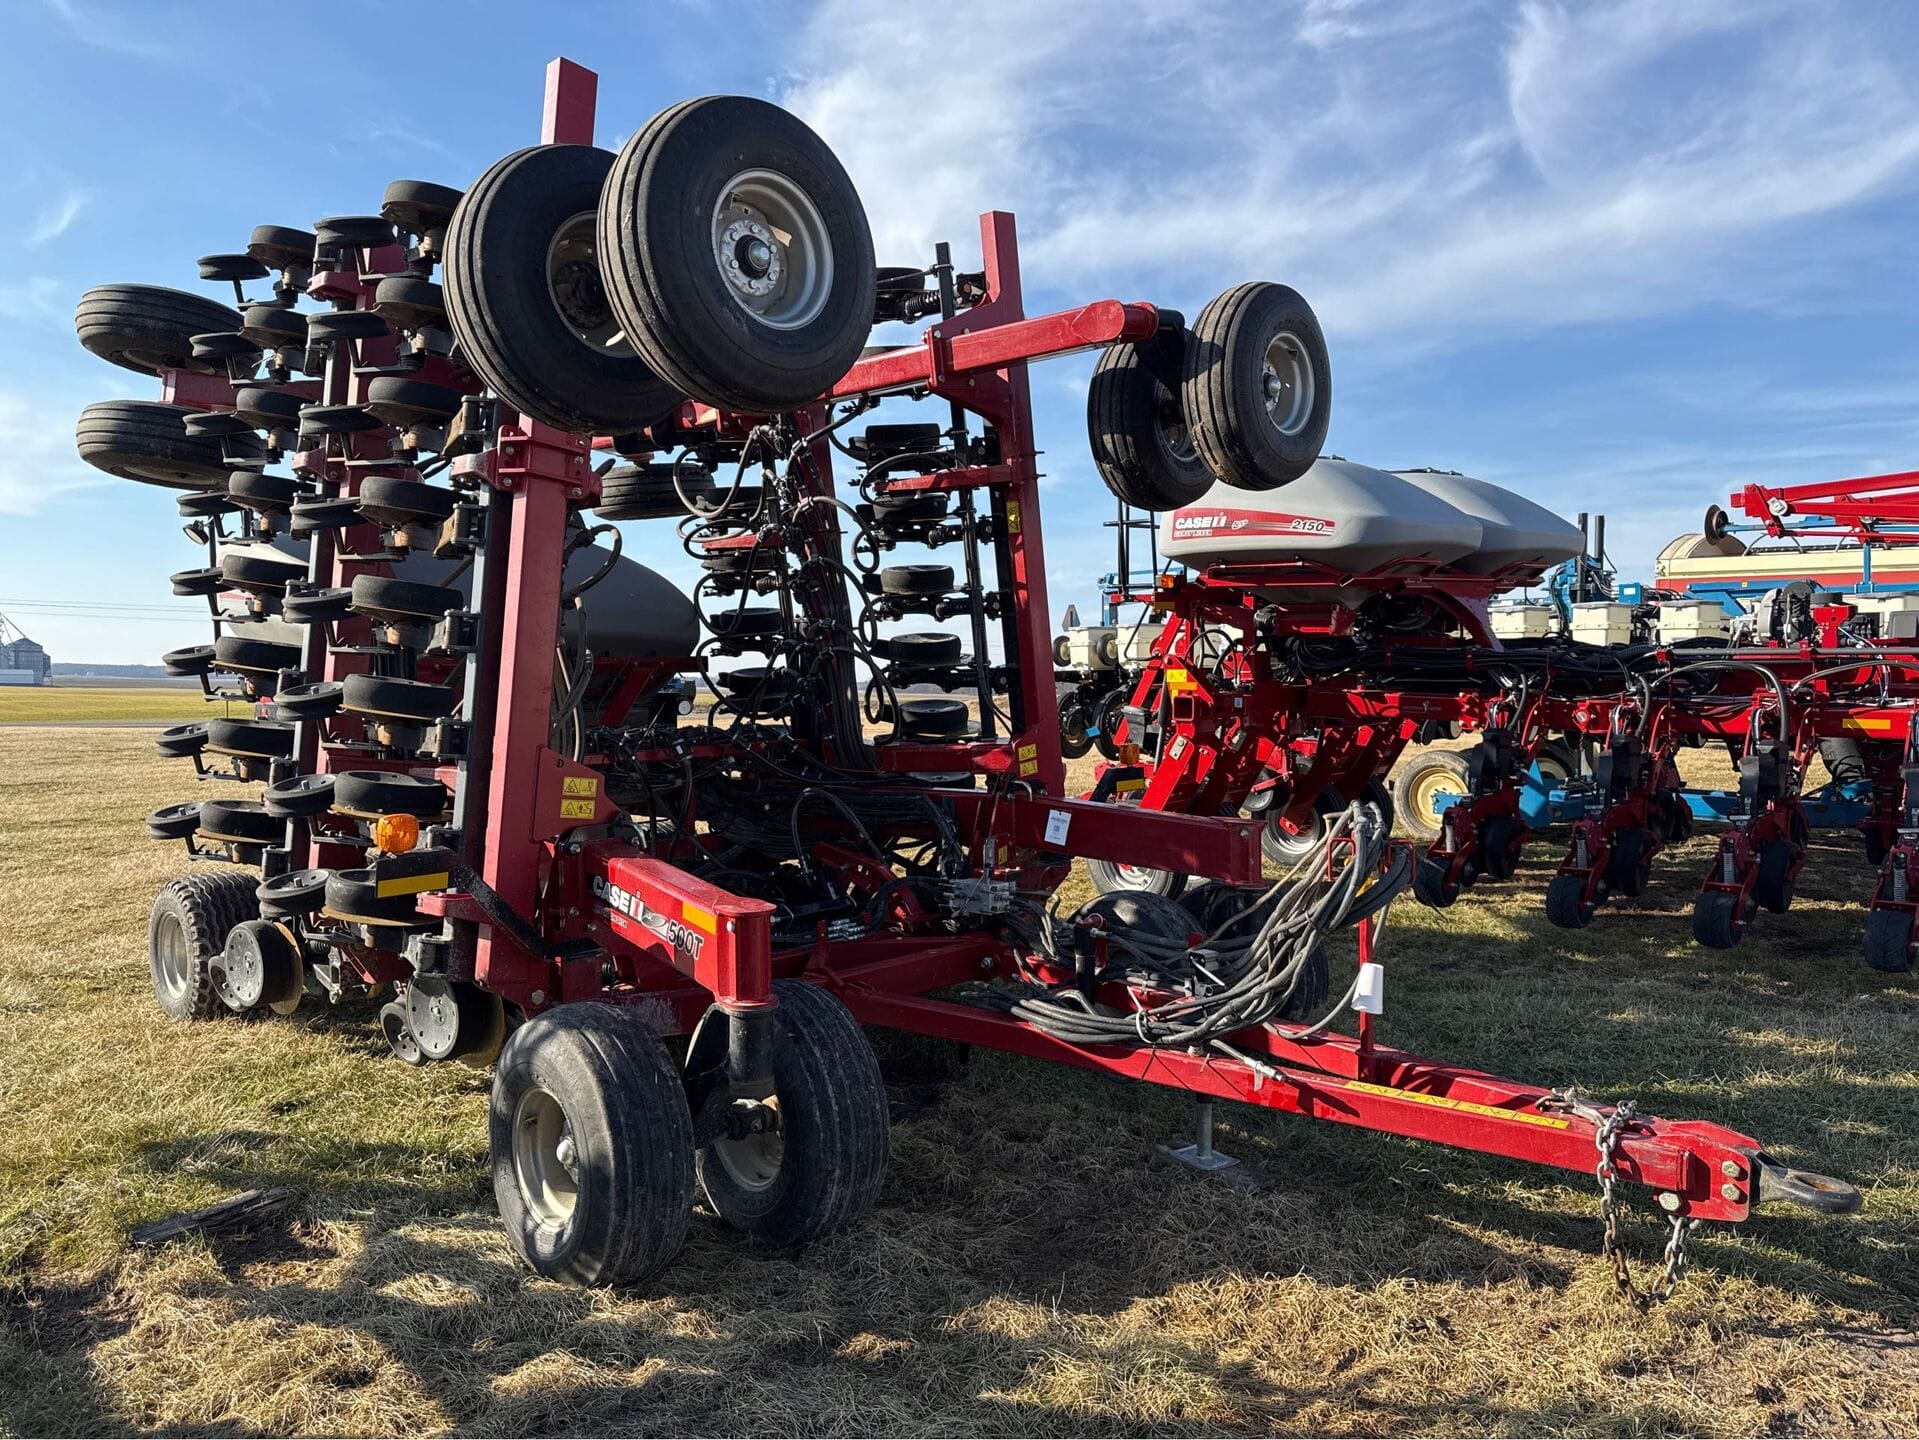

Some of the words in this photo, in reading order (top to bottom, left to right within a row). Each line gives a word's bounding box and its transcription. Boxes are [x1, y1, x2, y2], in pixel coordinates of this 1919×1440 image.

[1175, 516, 1213, 530] CASE
[1292, 519, 1325, 532] 2150
[593, 876, 631, 914] CASE
[668, 919, 704, 960] 500T
